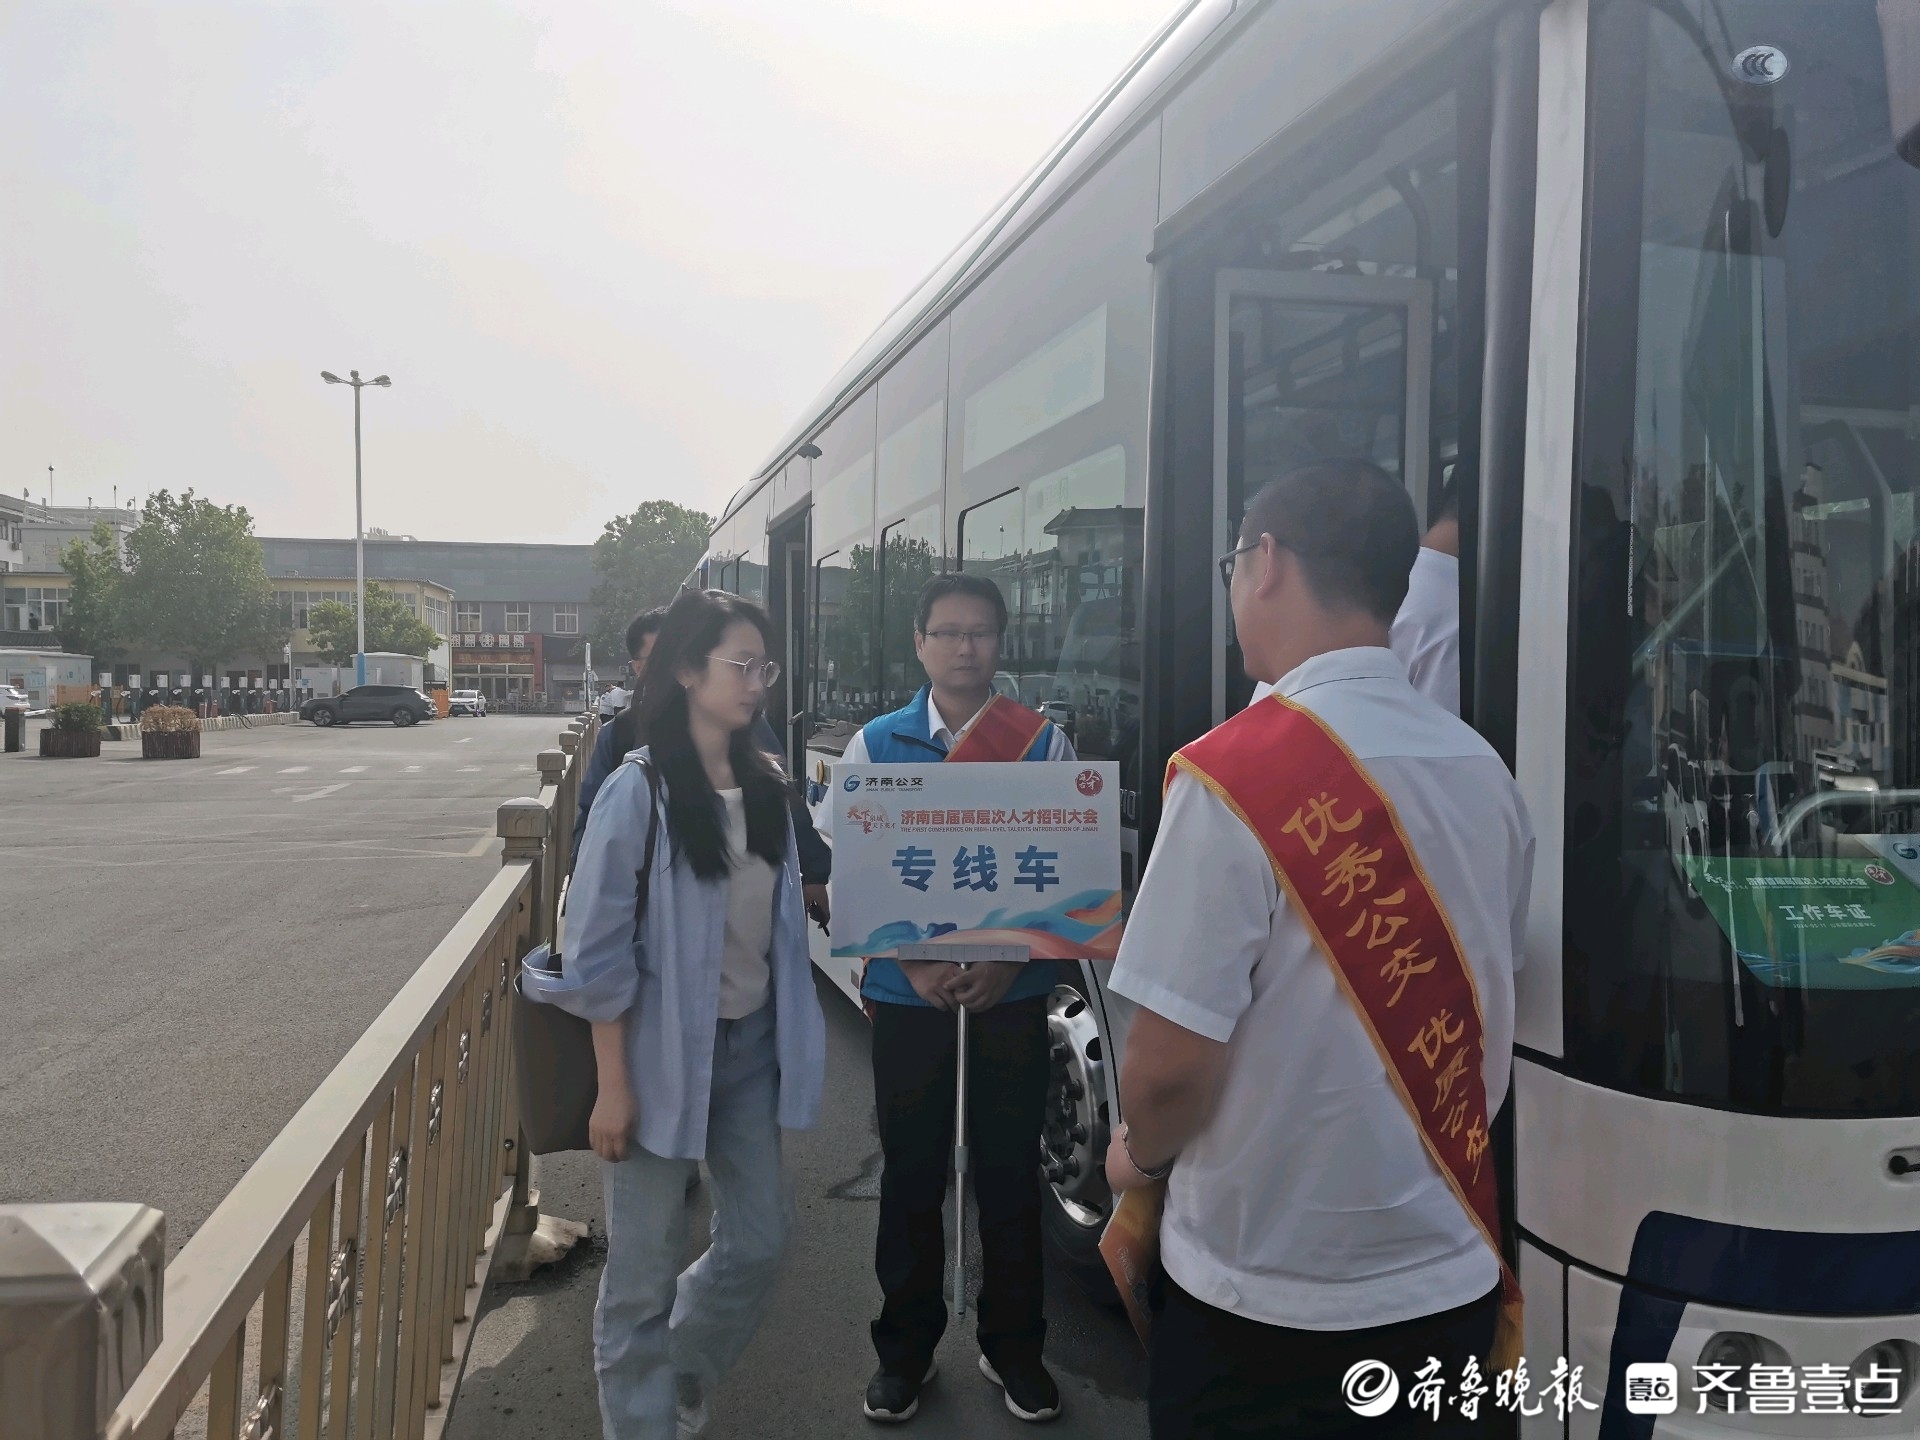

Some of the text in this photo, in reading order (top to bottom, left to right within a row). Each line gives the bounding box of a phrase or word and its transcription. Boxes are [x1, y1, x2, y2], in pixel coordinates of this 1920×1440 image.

[866, 777, 924, 787] 济南公交
[900, 809, 1098, 825] 济南首届高层次人才招引大会
[892, 845, 1060, 893] 专线车
[1281, 792, 1437, 1007] 优秀公交
[1779, 904, 1871, 921] 工作车证
